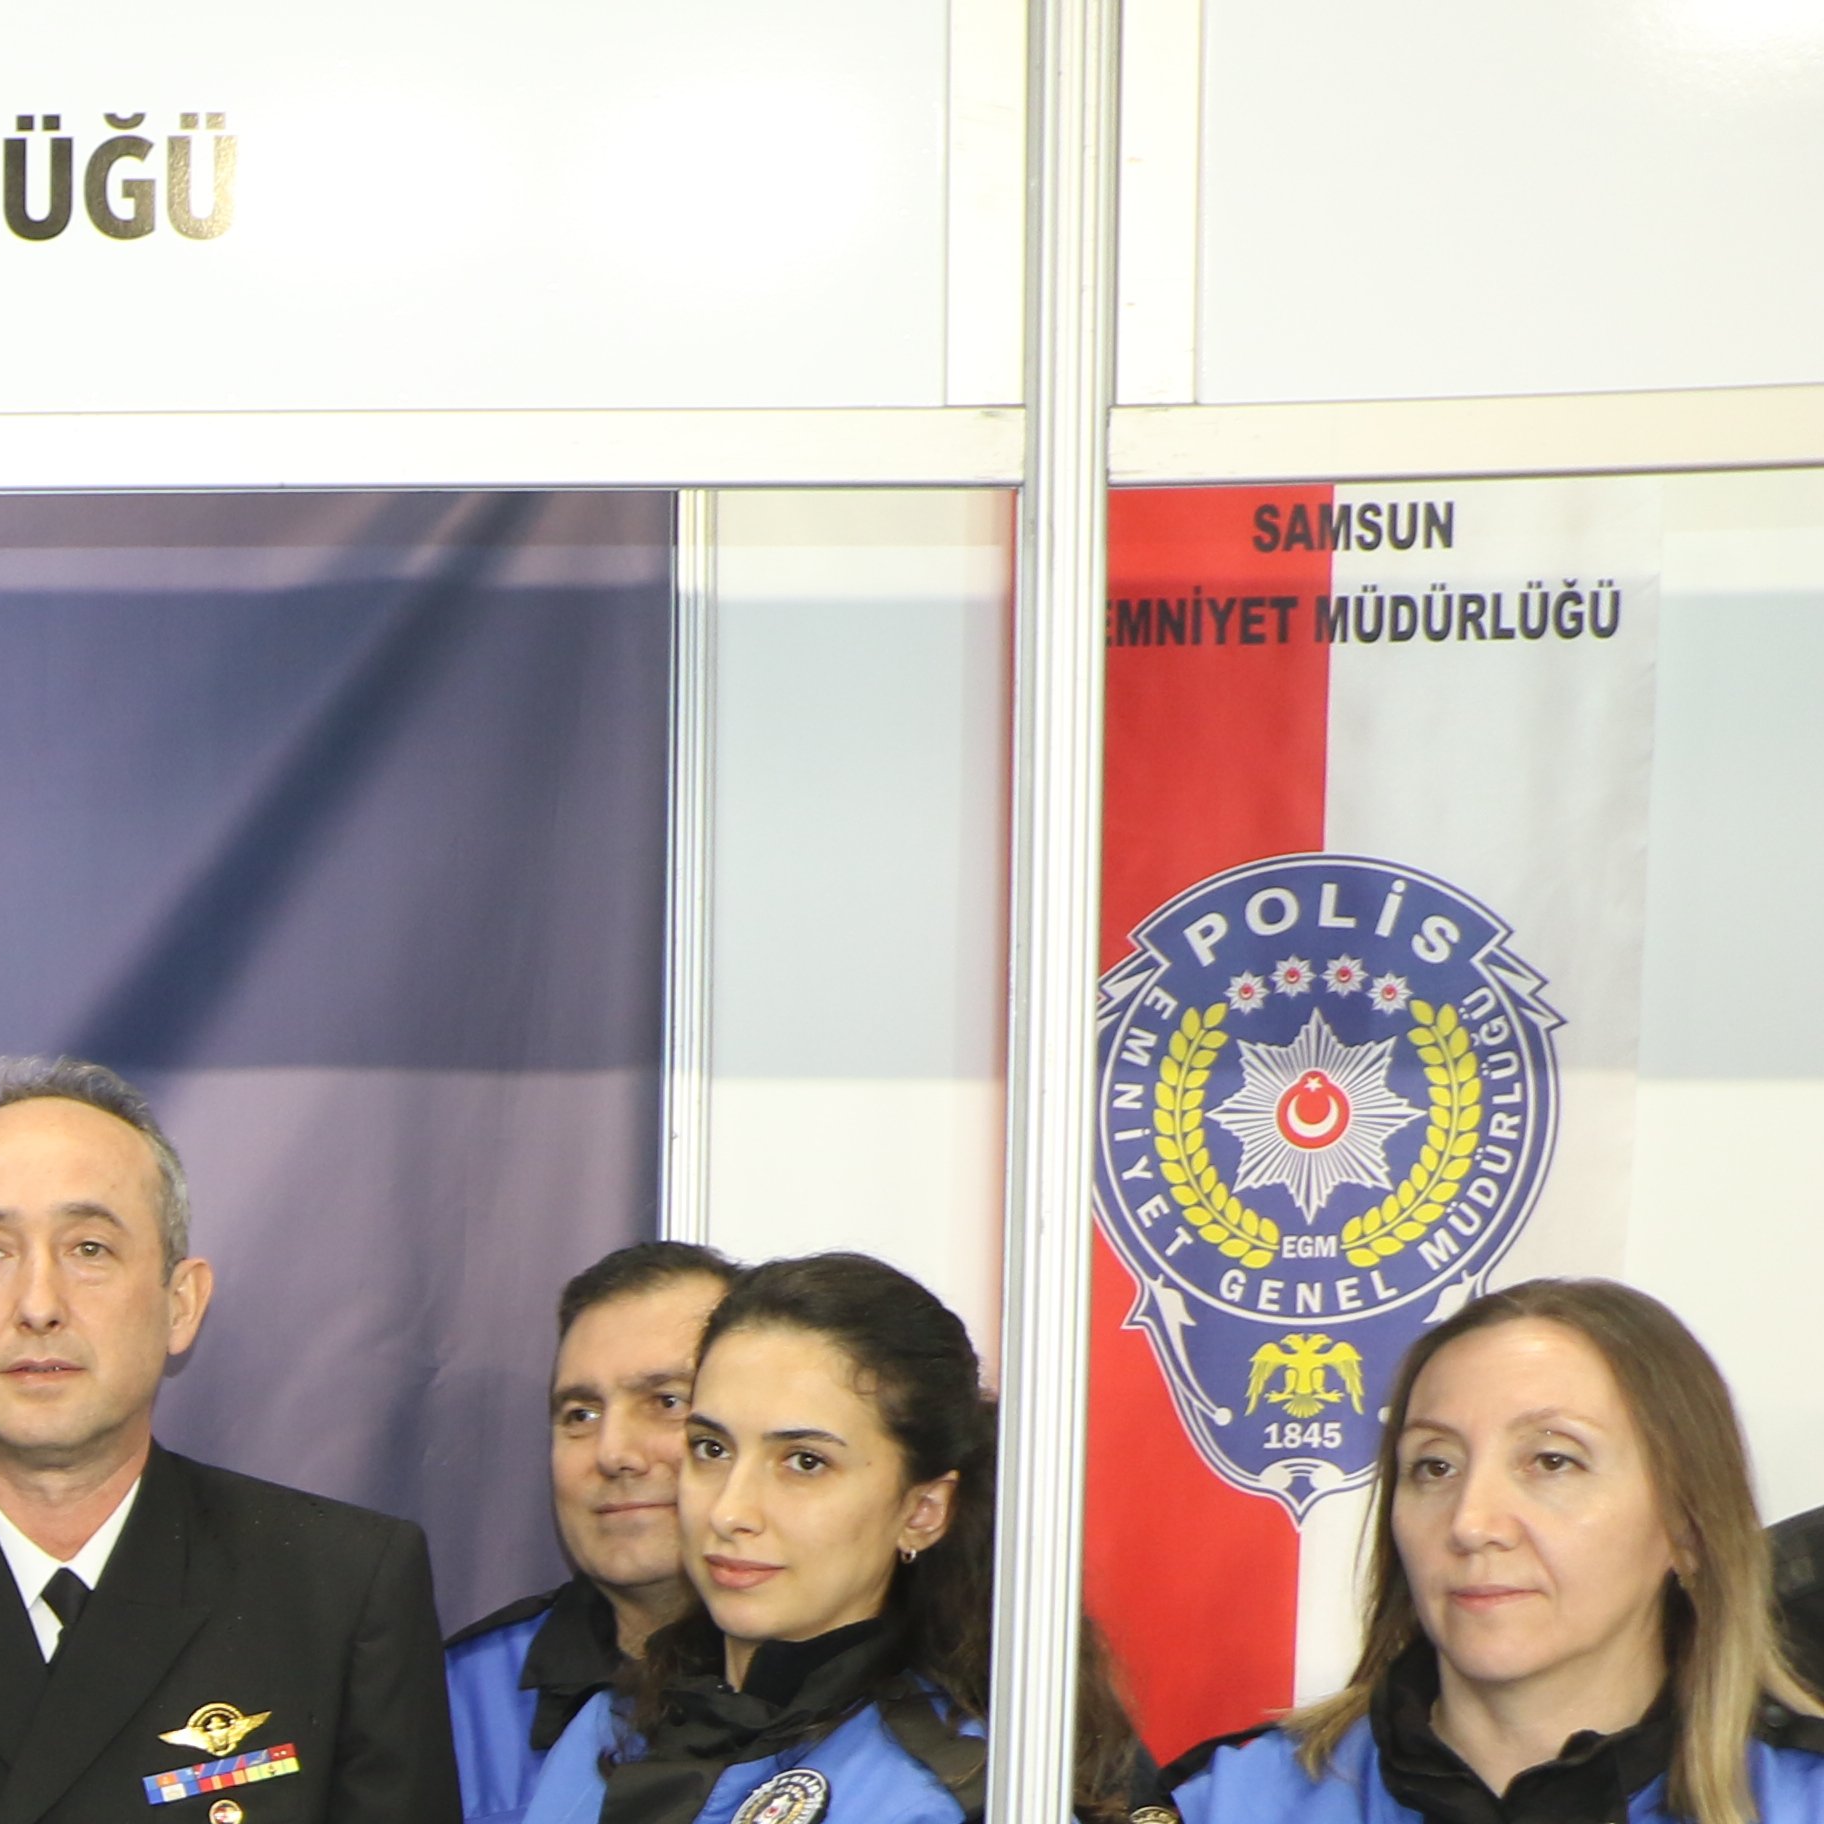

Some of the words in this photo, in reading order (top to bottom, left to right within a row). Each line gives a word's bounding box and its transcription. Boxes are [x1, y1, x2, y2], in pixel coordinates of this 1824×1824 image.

[1252, 501, 1455, 553] SAMSUN
[1315, 578, 1621, 645] MÜDÜRLÜĞÜ
[1183, 879, 1461, 967] POLİS
[1113, 985, 1194, 1258] EMNİYET
[1218, 1267, 1398, 1315] GENEL
[1417, 985, 1523, 1271] MÜDÜRLÜĞÜ
[1281, 1234, 1338, 1260] EGM
[1263, 1422, 1343, 1450] 1845
